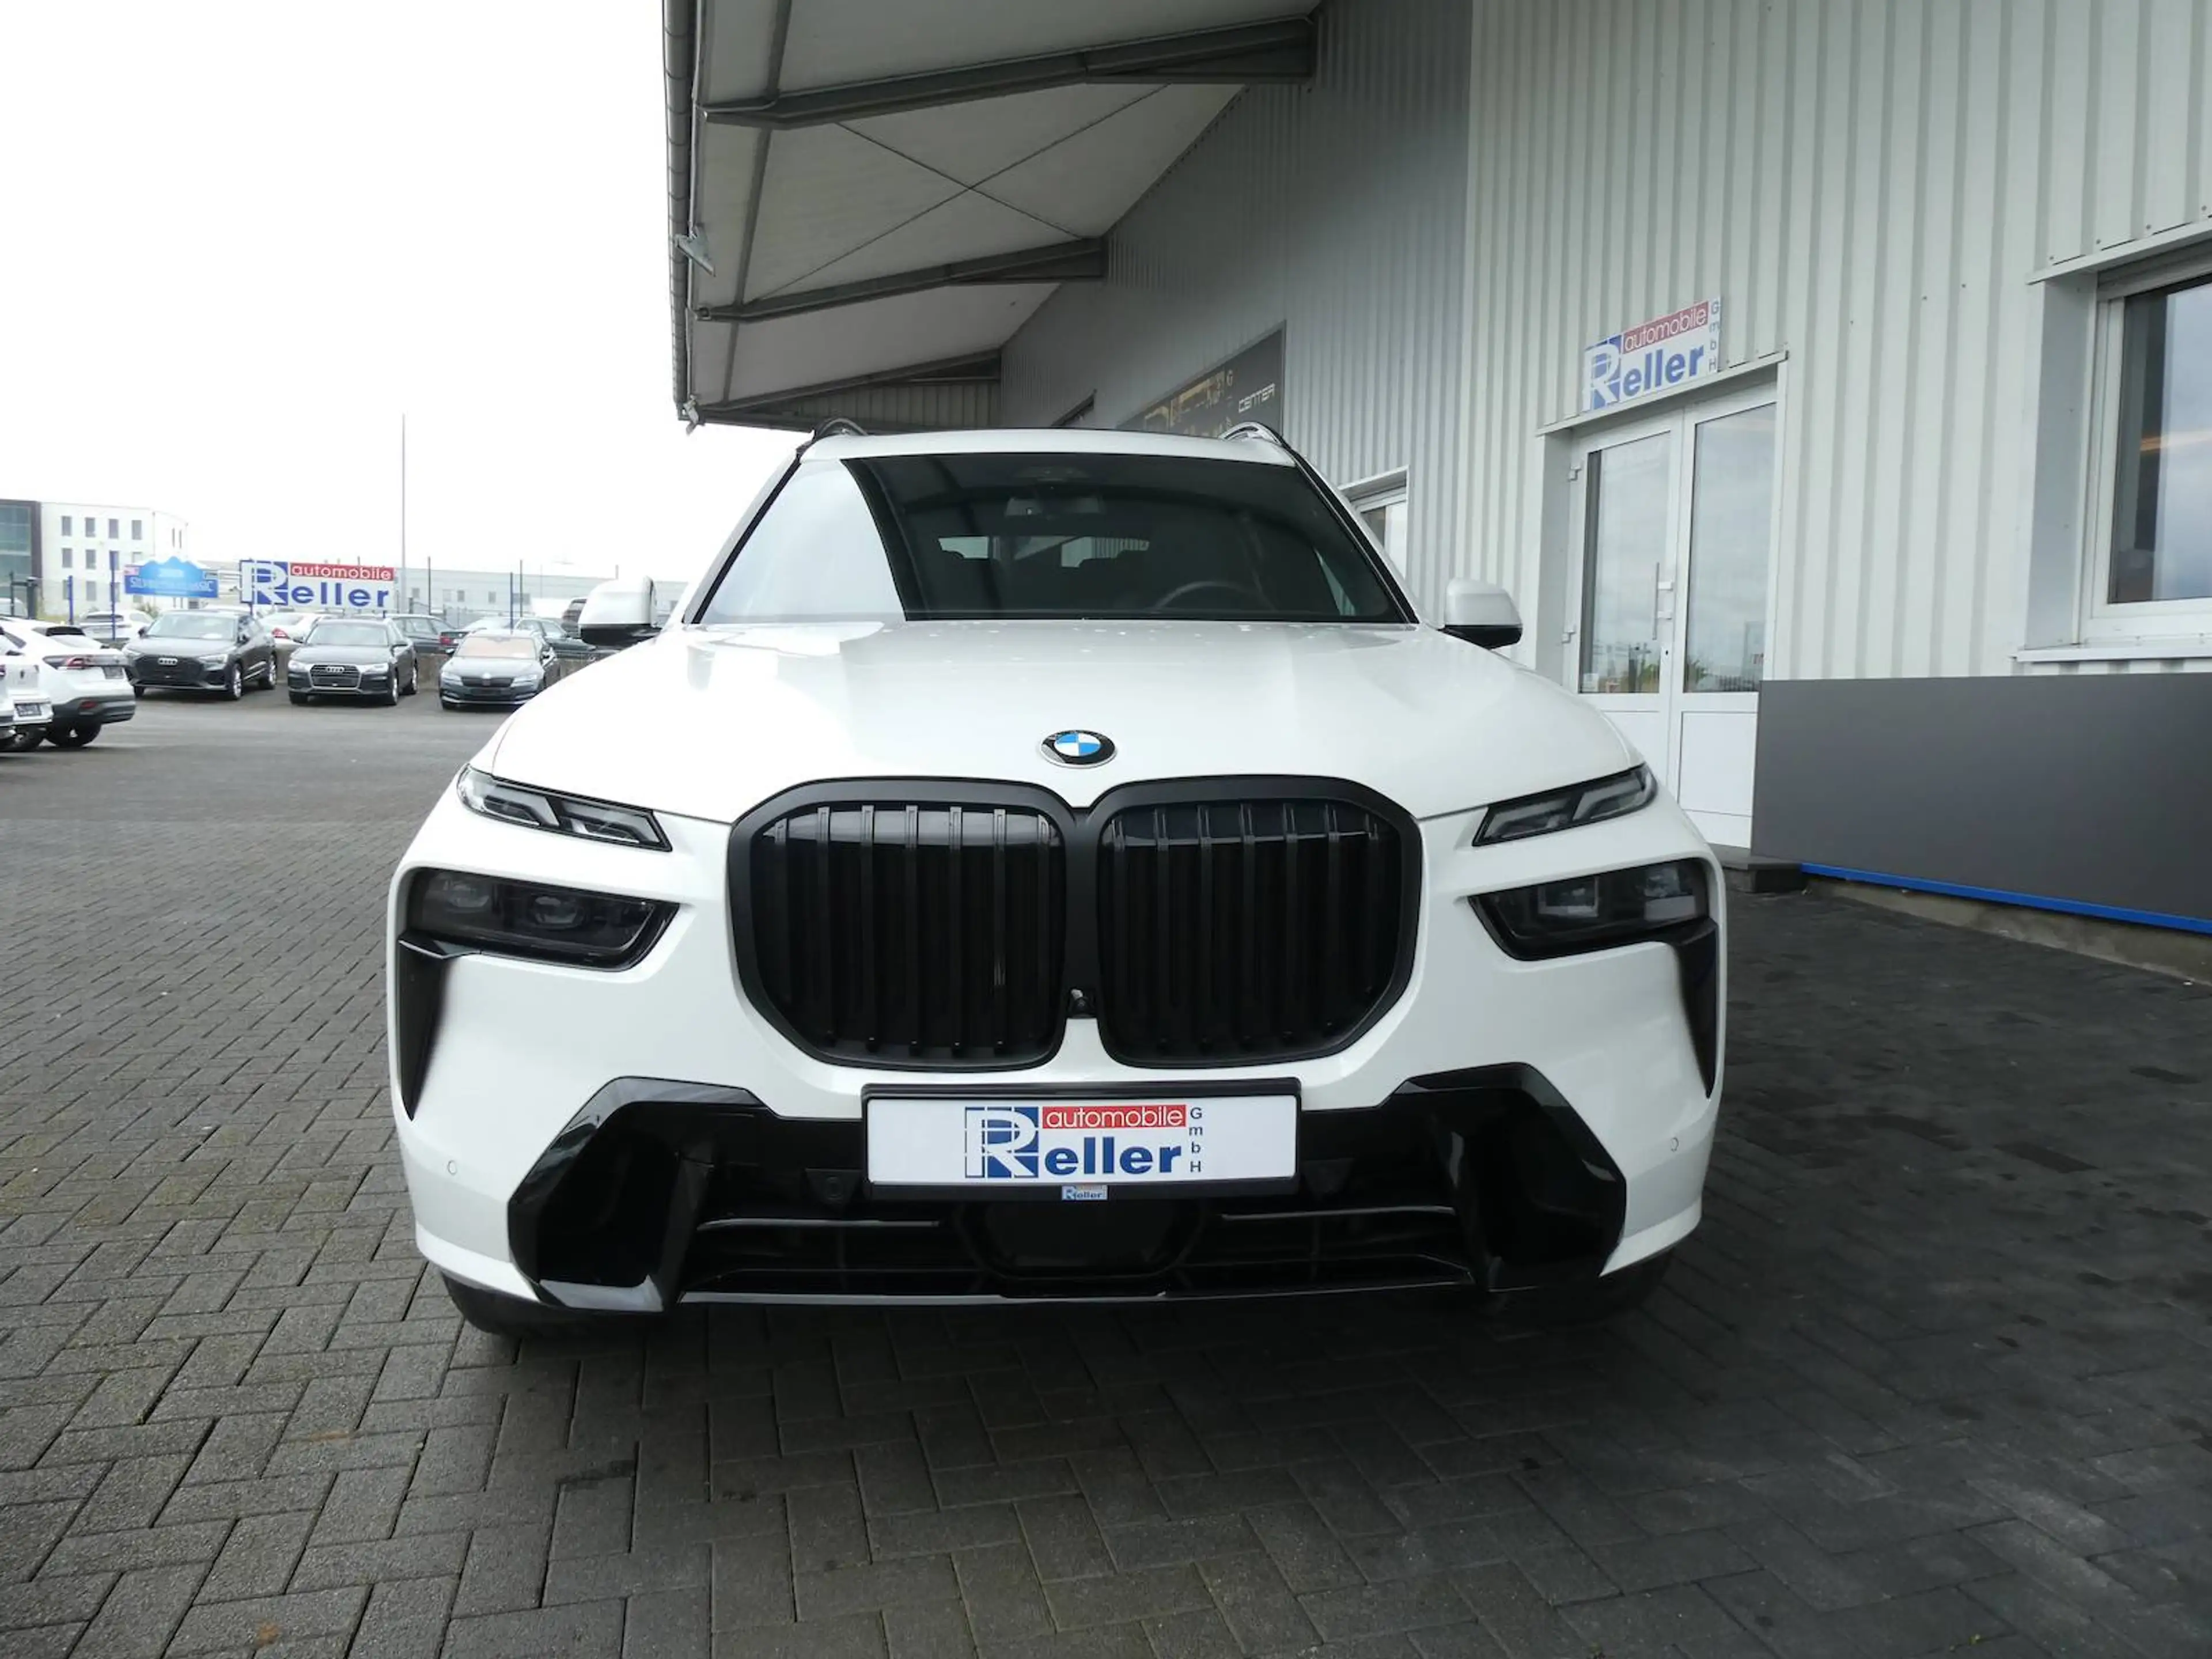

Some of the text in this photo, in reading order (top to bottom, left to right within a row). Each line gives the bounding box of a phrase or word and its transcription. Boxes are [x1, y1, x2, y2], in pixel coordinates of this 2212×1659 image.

[1624, 307, 1707, 351] automobile
[1709, 301, 1719, 373] GmbH
[1582, 342, 1704, 411] Reller
[240, 560, 389, 607] Reller
[291, 564, 392, 580] automobile
[965, 1107, 1182, 1177] Reller
[1046, 1106, 1183, 1127] automobile
[1189, 1107, 1203, 1172] GmbH
